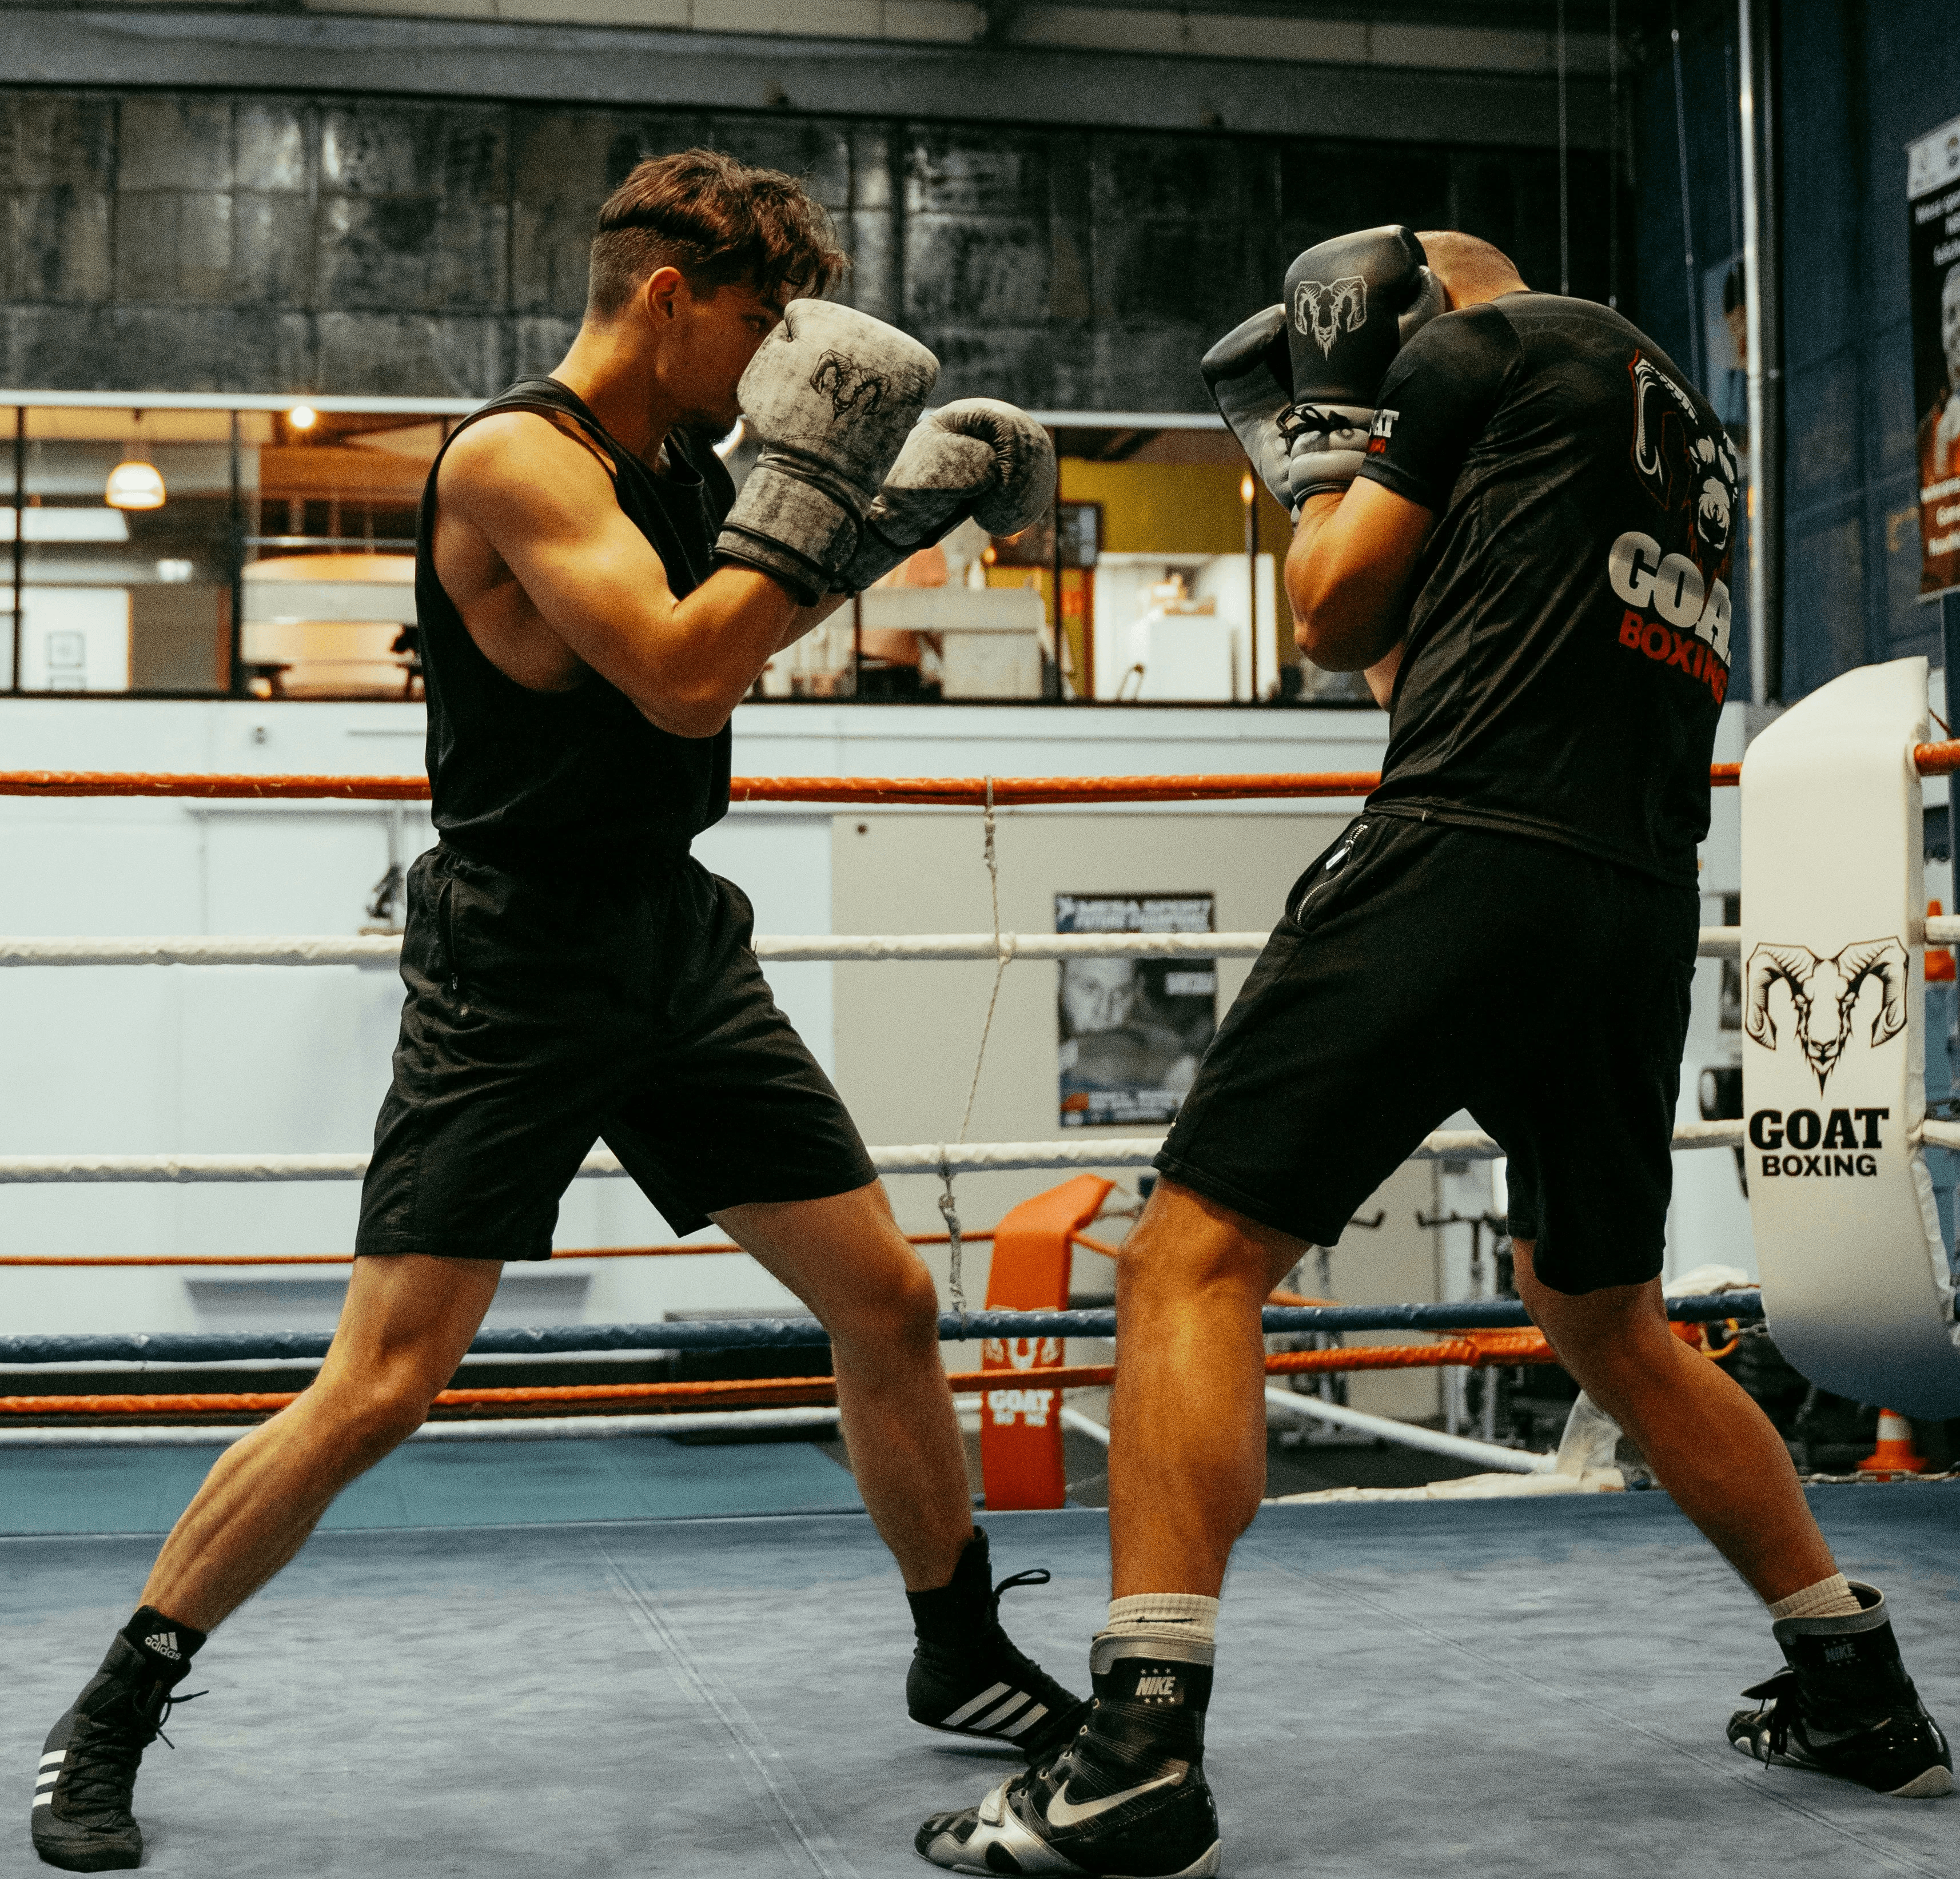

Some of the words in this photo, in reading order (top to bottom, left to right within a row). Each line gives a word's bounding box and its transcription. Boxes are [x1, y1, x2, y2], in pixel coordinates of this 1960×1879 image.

[1608, 531, 1731, 667] GOA
[1748, 1108, 1889, 1150] GOAT
[1762, 1154, 1877, 1176] BOXING
[988, 1390, 1053, 1411] GOAT
[145, 1637, 182, 1660] adidas
[1824, 1642, 1856, 1662] NIKE
[1135, 1676, 1176, 1695] NIKE
